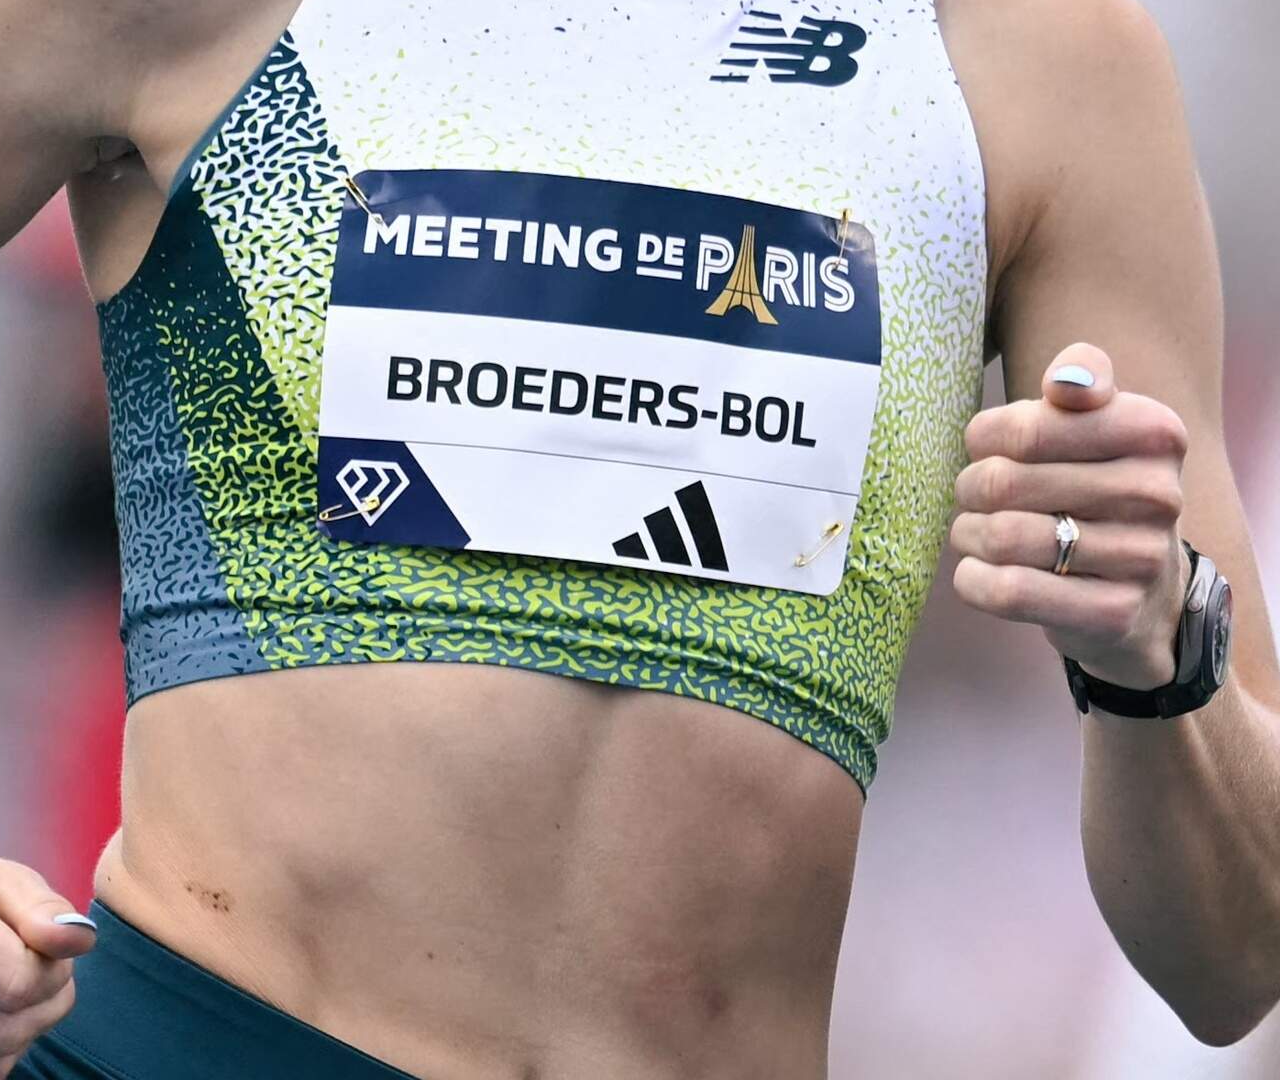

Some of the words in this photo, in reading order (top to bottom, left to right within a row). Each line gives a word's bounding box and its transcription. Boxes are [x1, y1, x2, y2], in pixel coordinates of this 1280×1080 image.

[363, 215, 622, 273] MEETING
[637, 234, 685, 280] DE
[387, 356, 817, 449] BROEDERS-BOL
